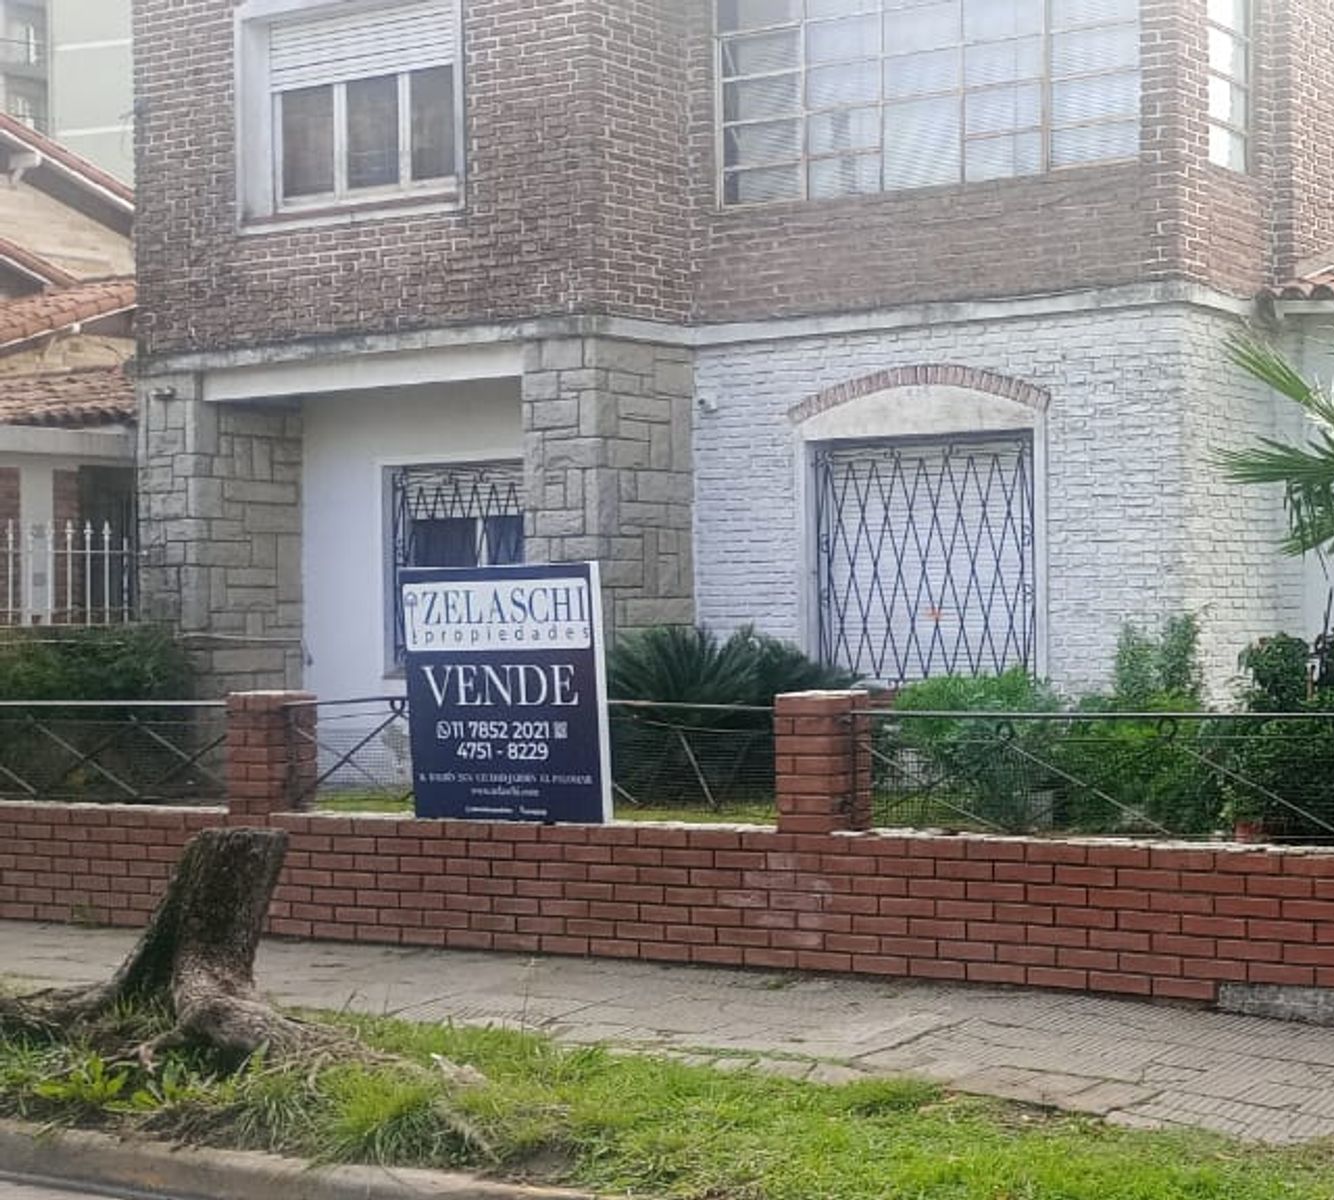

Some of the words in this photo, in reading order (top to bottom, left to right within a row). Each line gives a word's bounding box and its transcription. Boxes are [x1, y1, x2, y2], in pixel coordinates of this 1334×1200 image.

[422, 587, 588, 624] ZELASCHI
[425, 625, 590, 644] propiedades
[422, 664, 579, 707] VENDE
[452, 721, 465, 739] 11
[468, 720, 509, 740] 7852
[513, 719, 550, 740] 2021
[456, 742, 492, 760] 4751
[507, 741, 549, 761] 8229
